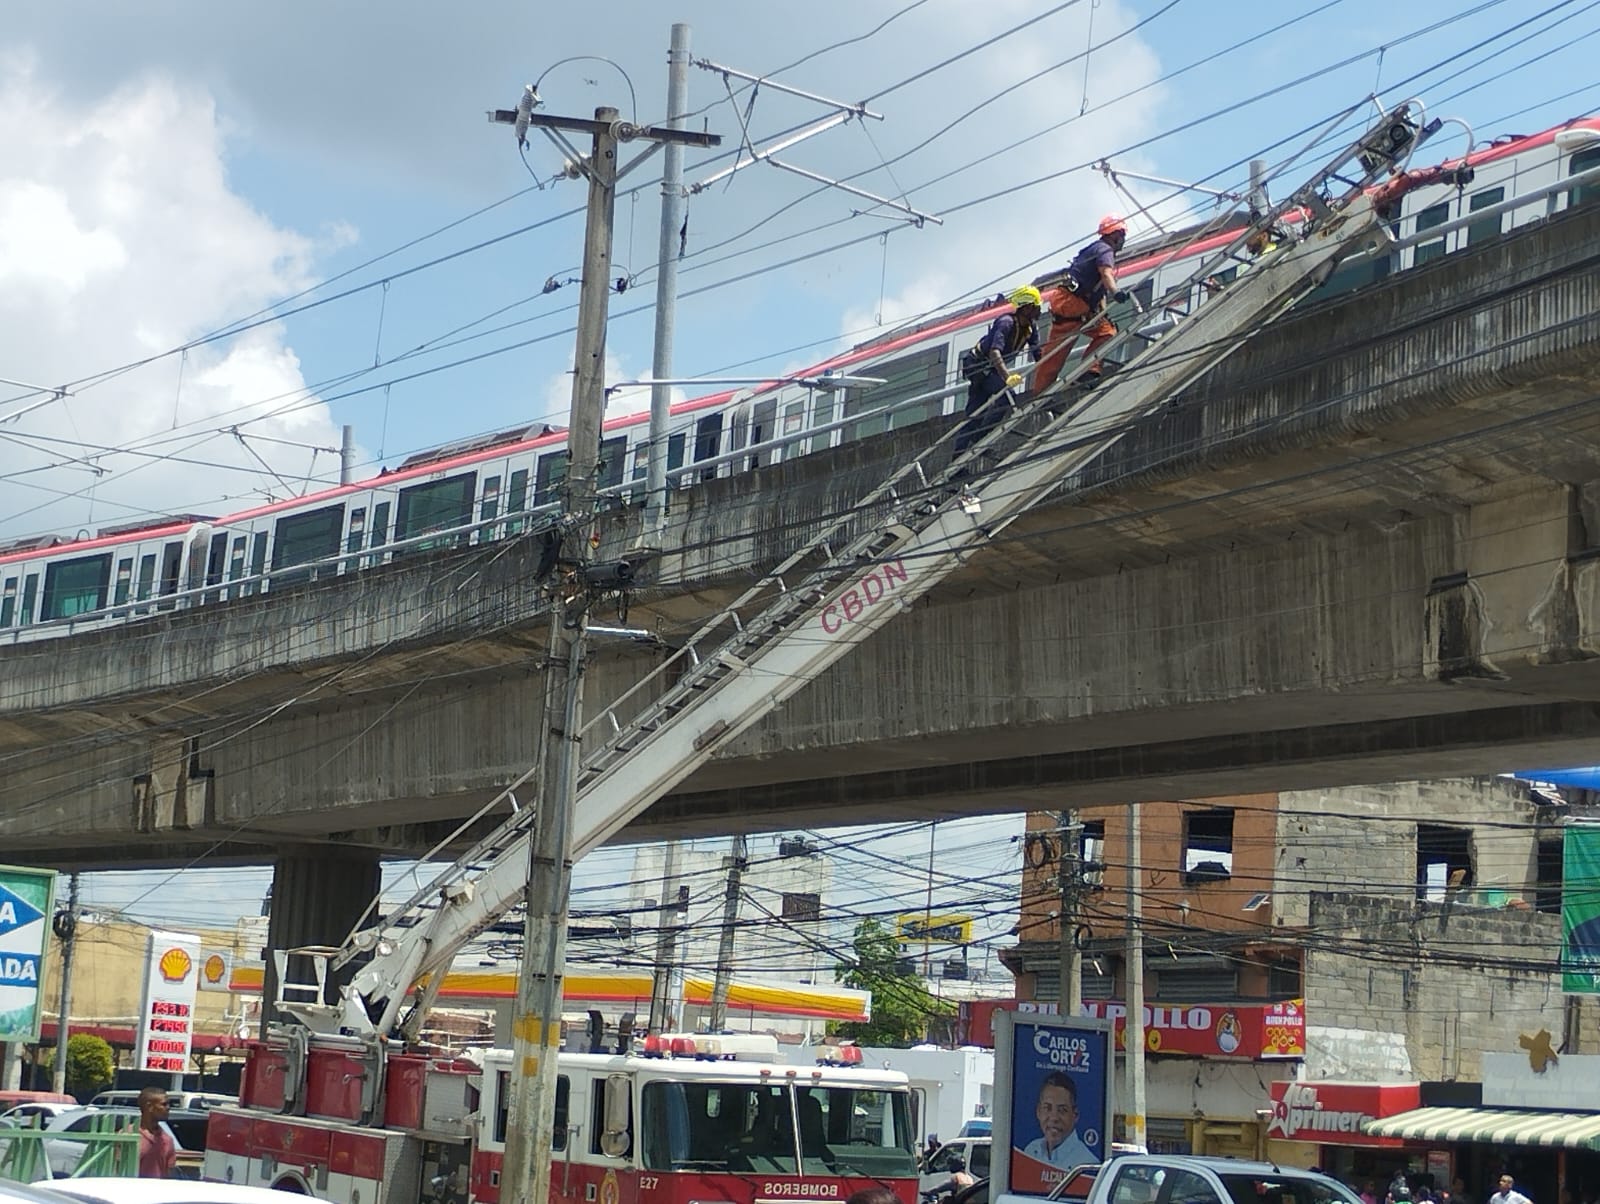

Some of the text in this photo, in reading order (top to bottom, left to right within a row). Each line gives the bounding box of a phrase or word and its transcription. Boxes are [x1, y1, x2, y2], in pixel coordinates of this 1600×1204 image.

[822, 559, 908, 634] CBDN
[0, 957, 37, 981] DA
[1033, 1030, 1087, 1054] CARLOS
[1293, 1085, 1318, 1105] La
[640, 1176, 659, 1190] E27
